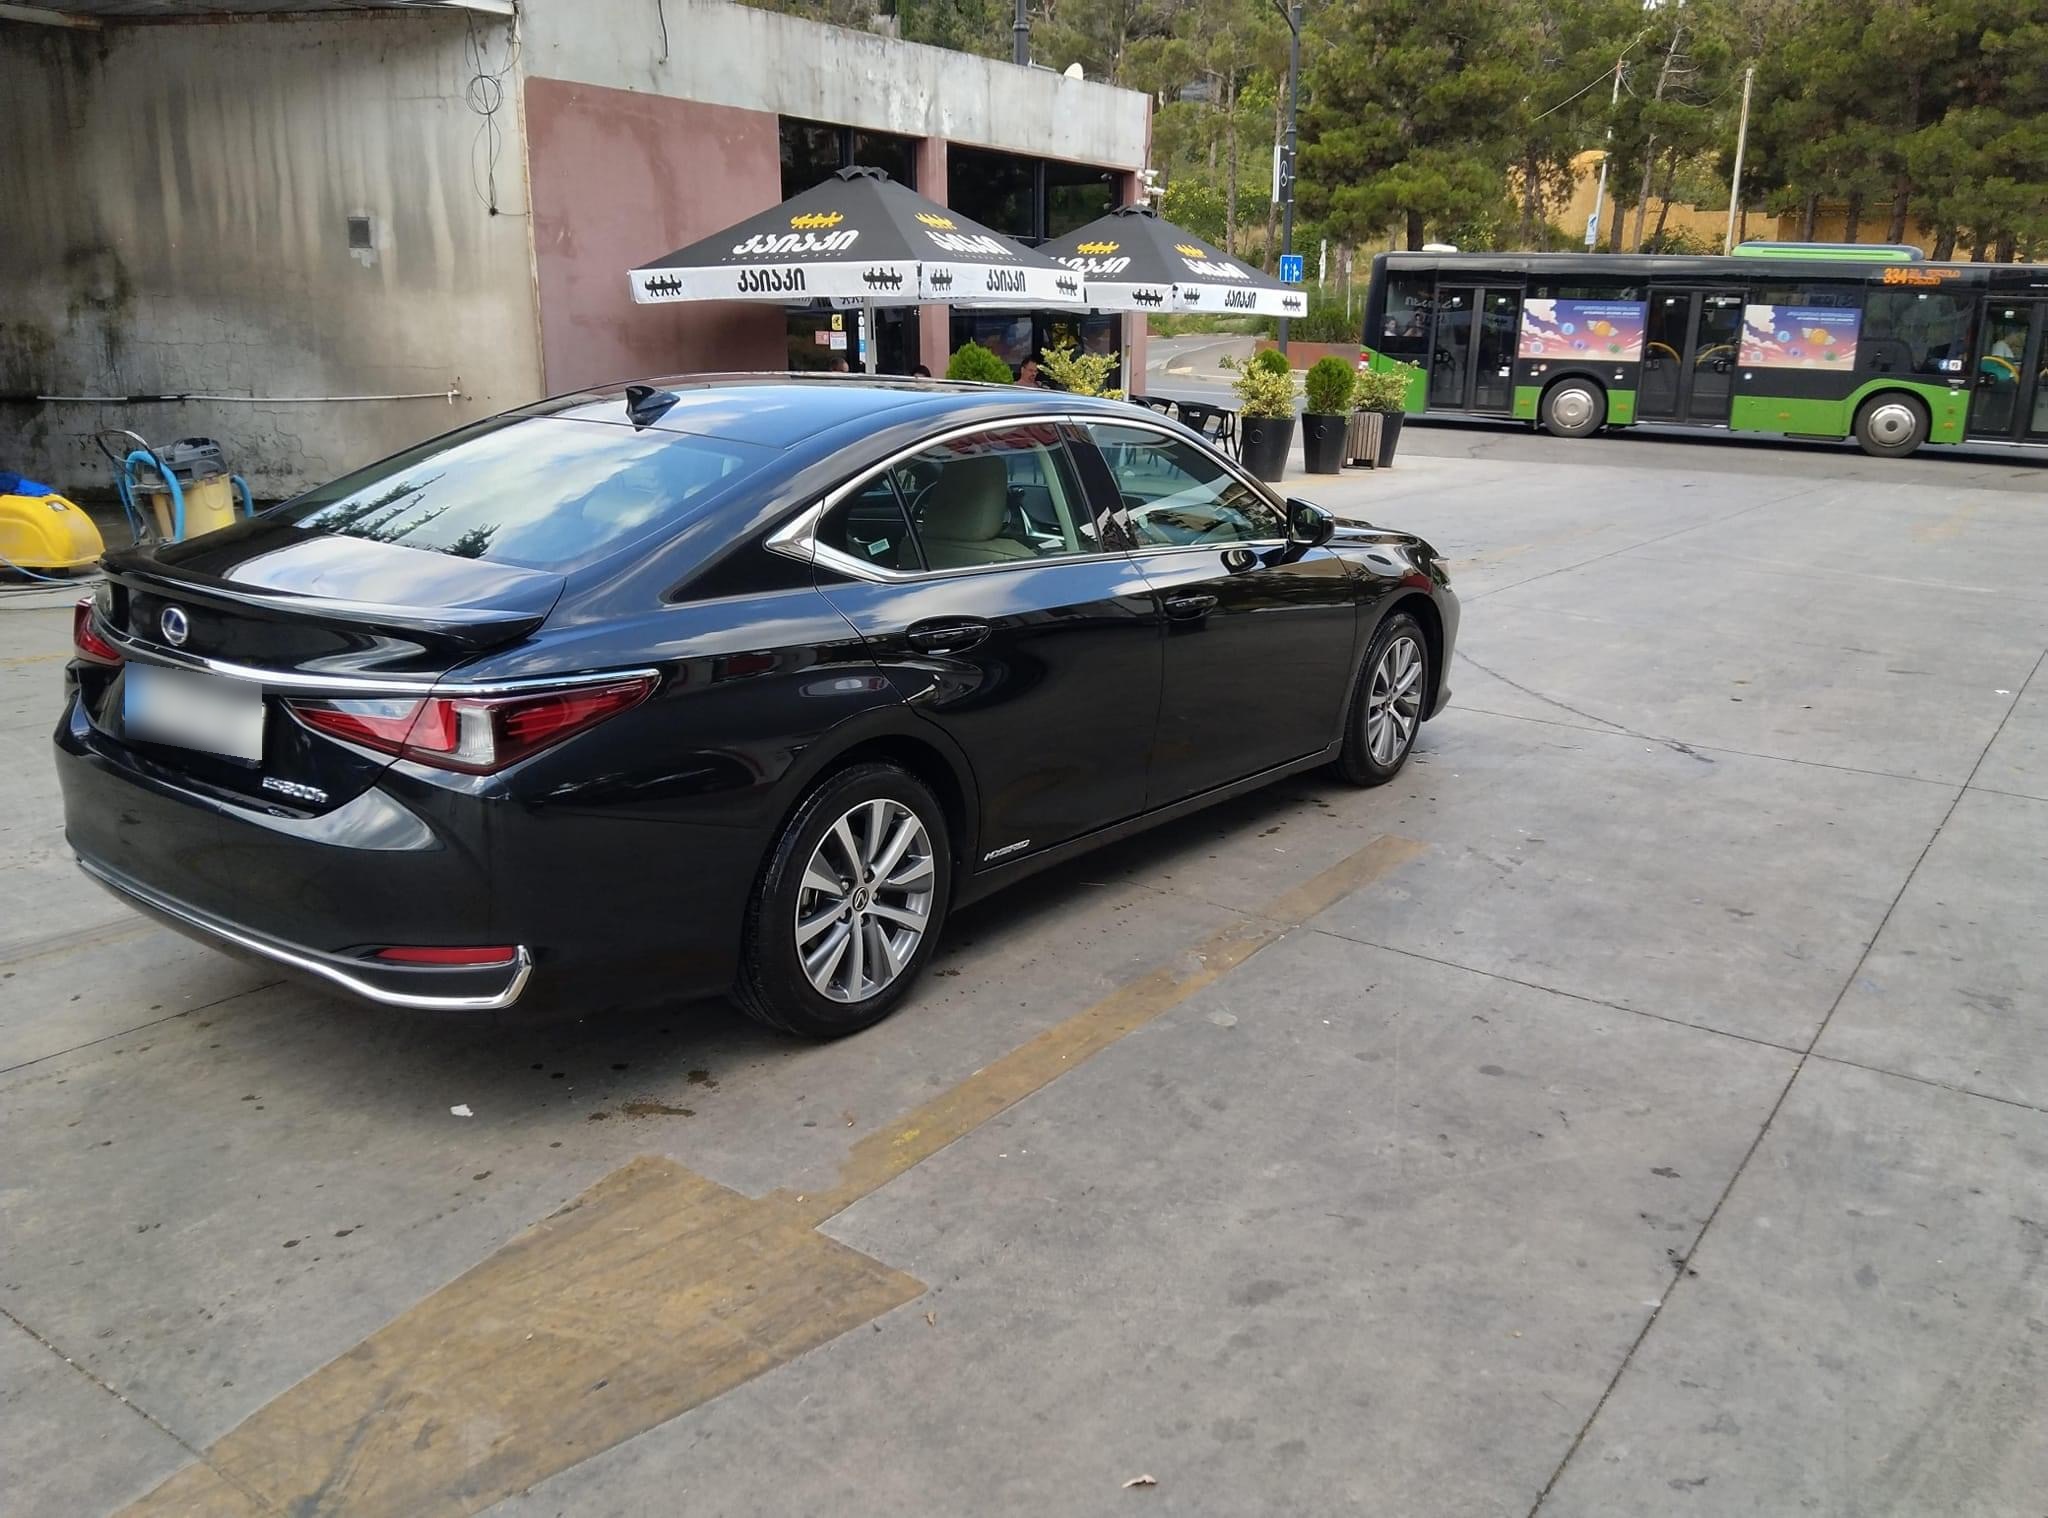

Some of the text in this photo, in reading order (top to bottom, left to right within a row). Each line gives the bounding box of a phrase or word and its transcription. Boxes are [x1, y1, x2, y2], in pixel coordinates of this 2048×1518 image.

[732, 229, 860, 255] კაიაკი
[736, 267, 807, 292] კაიაკი
[985, 268, 1027, 293] კაიაკი
[1224, 289, 1257, 309] კაიაკი
